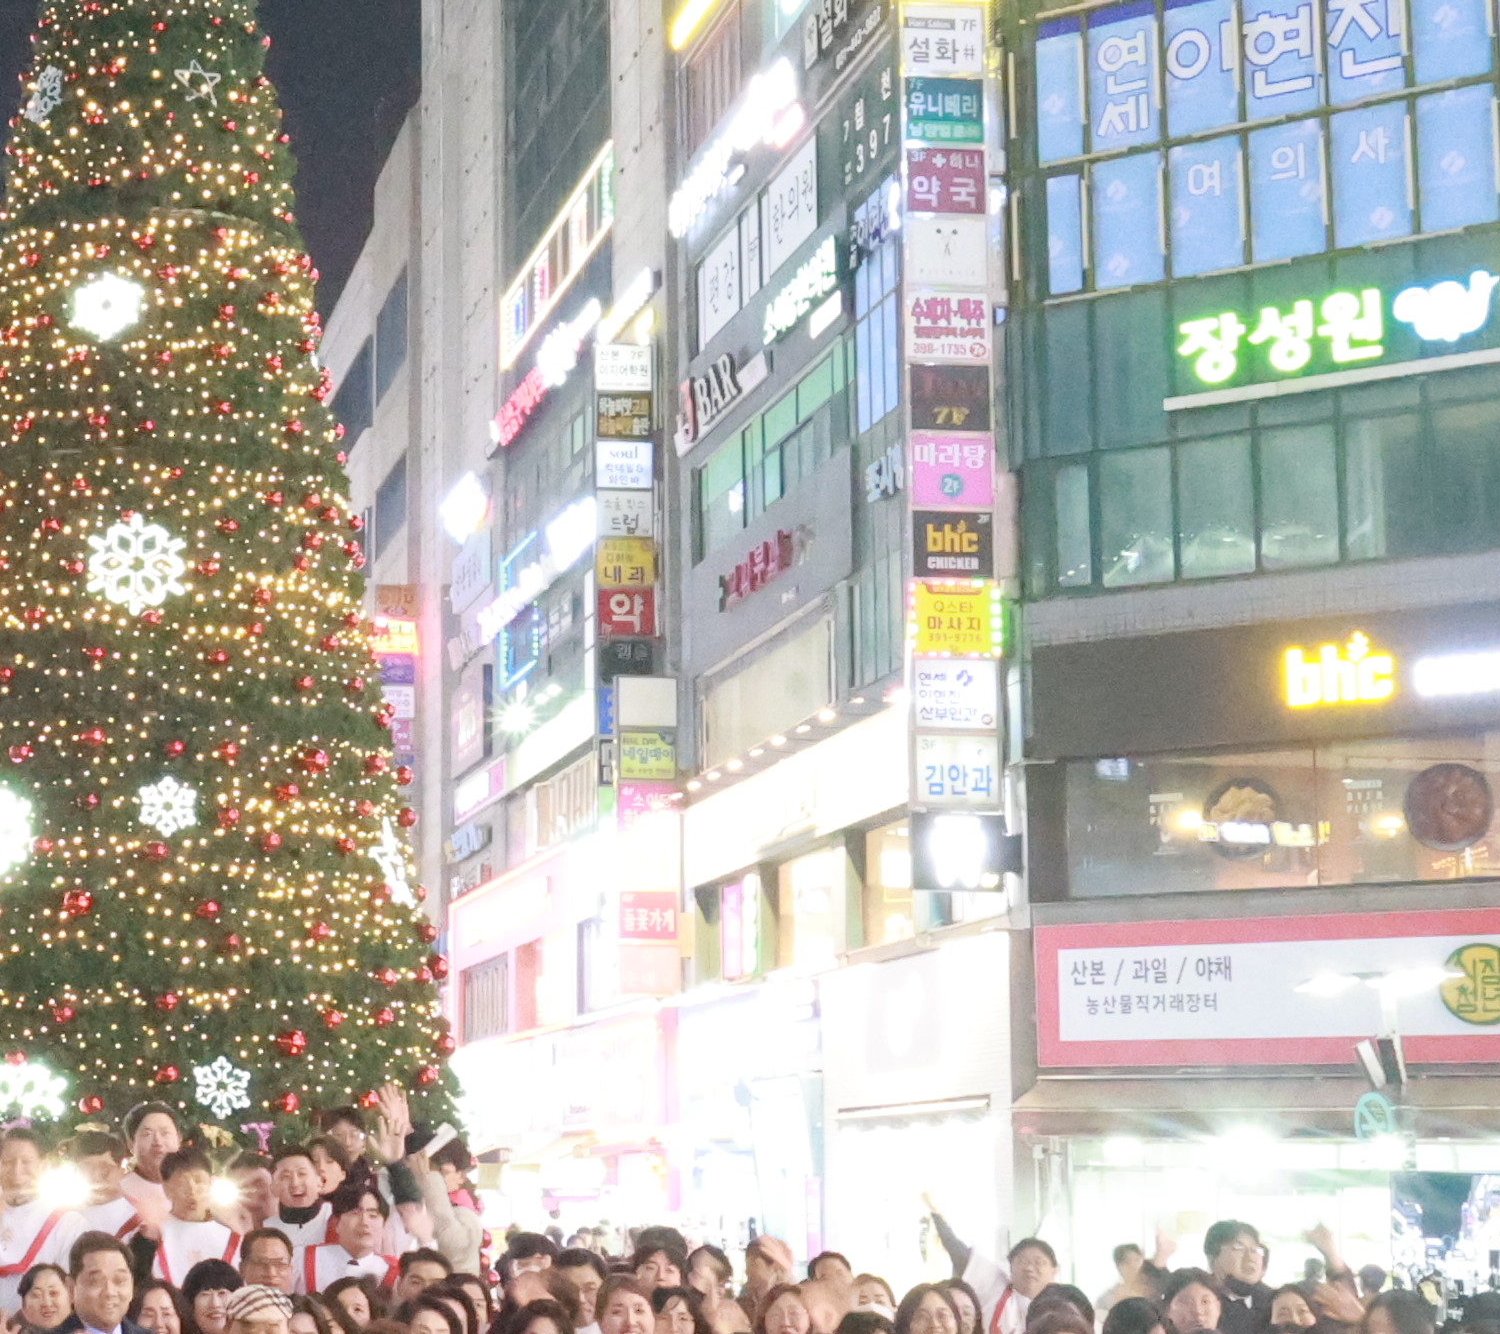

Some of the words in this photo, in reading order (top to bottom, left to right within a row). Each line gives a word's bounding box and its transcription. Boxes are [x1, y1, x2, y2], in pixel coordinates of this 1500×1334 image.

[961, 18, 978, 32] 7F
[908, 38, 960, 65] 설화
[1096, 34, 1154, 138] 연세
[911, 150, 927, 163] 3F
[912, 175, 978, 210] 약국
[913, 342, 967, 355] 398-1735
[1178, 288, 1386, 383] 장성원
[609, 444, 639, 460] soul
[914, 443, 986, 468] 마라탕
[942, 475, 960, 495] 2F
[926, 518, 980, 554] bhc
[927, 616, 982, 632] 마사지
[1286, 632, 1394, 709] bhc
[925, 764, 993, 798] 김안과
[1070, 960, 1107, 987] 산본
[1131, 958, 1169, 984] 과일
[1195, 955, 1233, 982] 야채
[1085, 993, 1218, 1016] 농산물직거래장터
